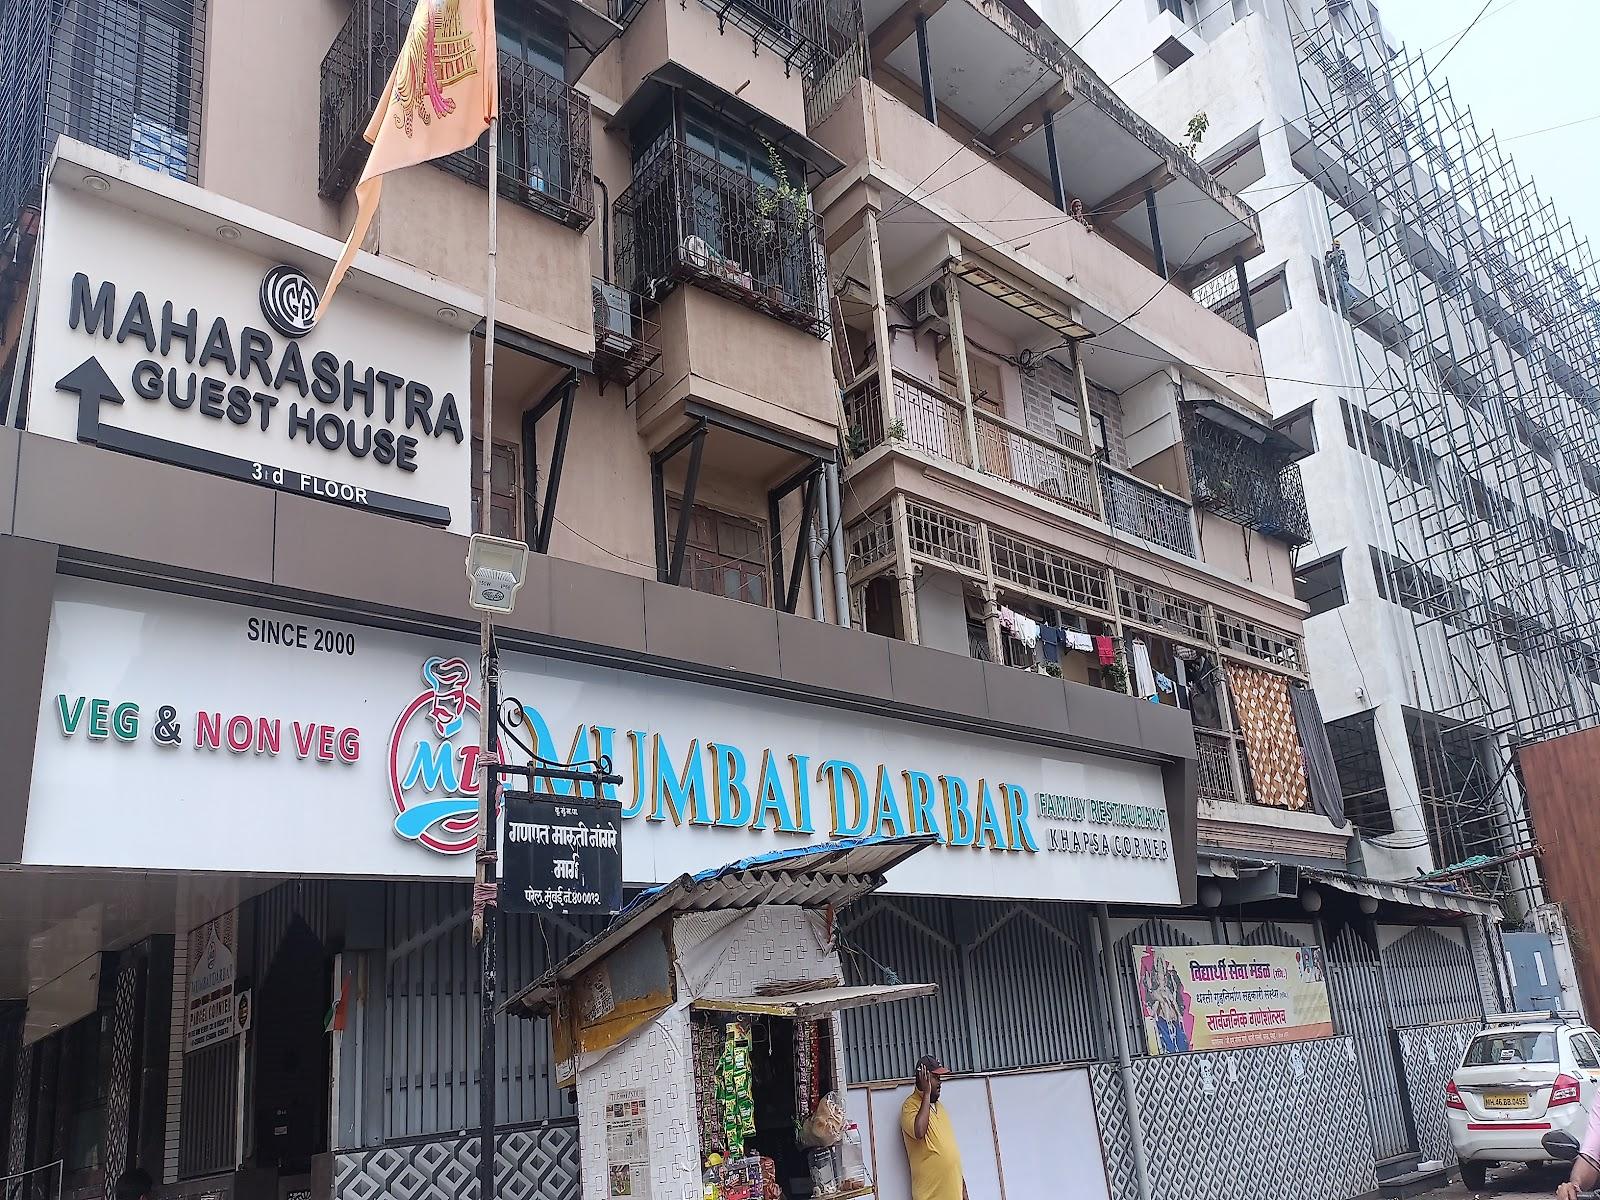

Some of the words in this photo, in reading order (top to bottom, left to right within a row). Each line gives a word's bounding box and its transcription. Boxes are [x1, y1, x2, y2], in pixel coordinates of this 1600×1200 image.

[69, 271, 464, 445] MAHARASHTRA
[131, 359, 278, 432] GUEST
[287, 402, 418, 473] HOUSE
[300, 474, 368, 504] FLOOR
[247, 617, 308, 649] SINCE
[313, 628, 356, 656] 2000
[57, 693, 140, 742] VEG
[152, 704, 182, 747] &
[193, 710, 281, 758] NON
[292, 720, 362, 764] VEG
[514, 705, 818, 835] MUMBAI
[815, 757, 1040, 853] DARBAR
[1034, 792, 1086, 822] FAMILY
[1087, 798, 1168, 832] RESTAURANT
[508, 821, 551, 846] गणपत
[1047, 828, 1111, 856] KHAPSA
[1111, 835, 1170, 860] CORNER
[552, 852, 580, 880] मार्ग
[1189, 957, 1228, 982] विद्यार्थी
[1228, 959, 1249, 981] सेवा
[1248, 958, 1271, 979] मंडळ
[1205, 1007, 1248, 1032] सार्वजनिक
[1249, 1006, 1287, 1028] गणेशोत्सव
